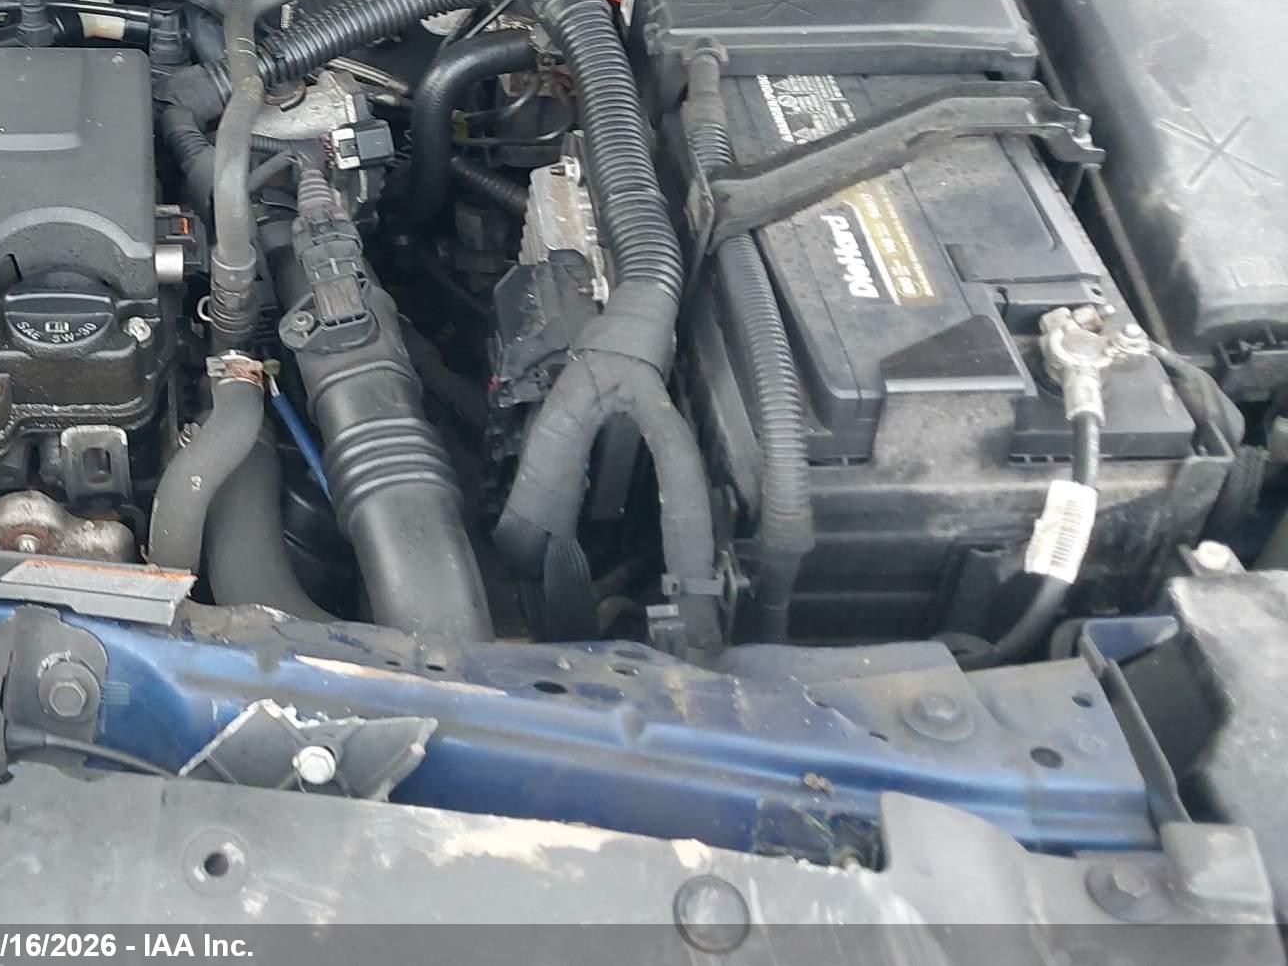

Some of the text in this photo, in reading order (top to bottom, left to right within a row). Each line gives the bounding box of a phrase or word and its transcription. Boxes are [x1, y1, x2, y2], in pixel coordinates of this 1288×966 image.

[819, 215, 880, 298] DieHard
[16, 321, 98, 344] SAE 5W-30
